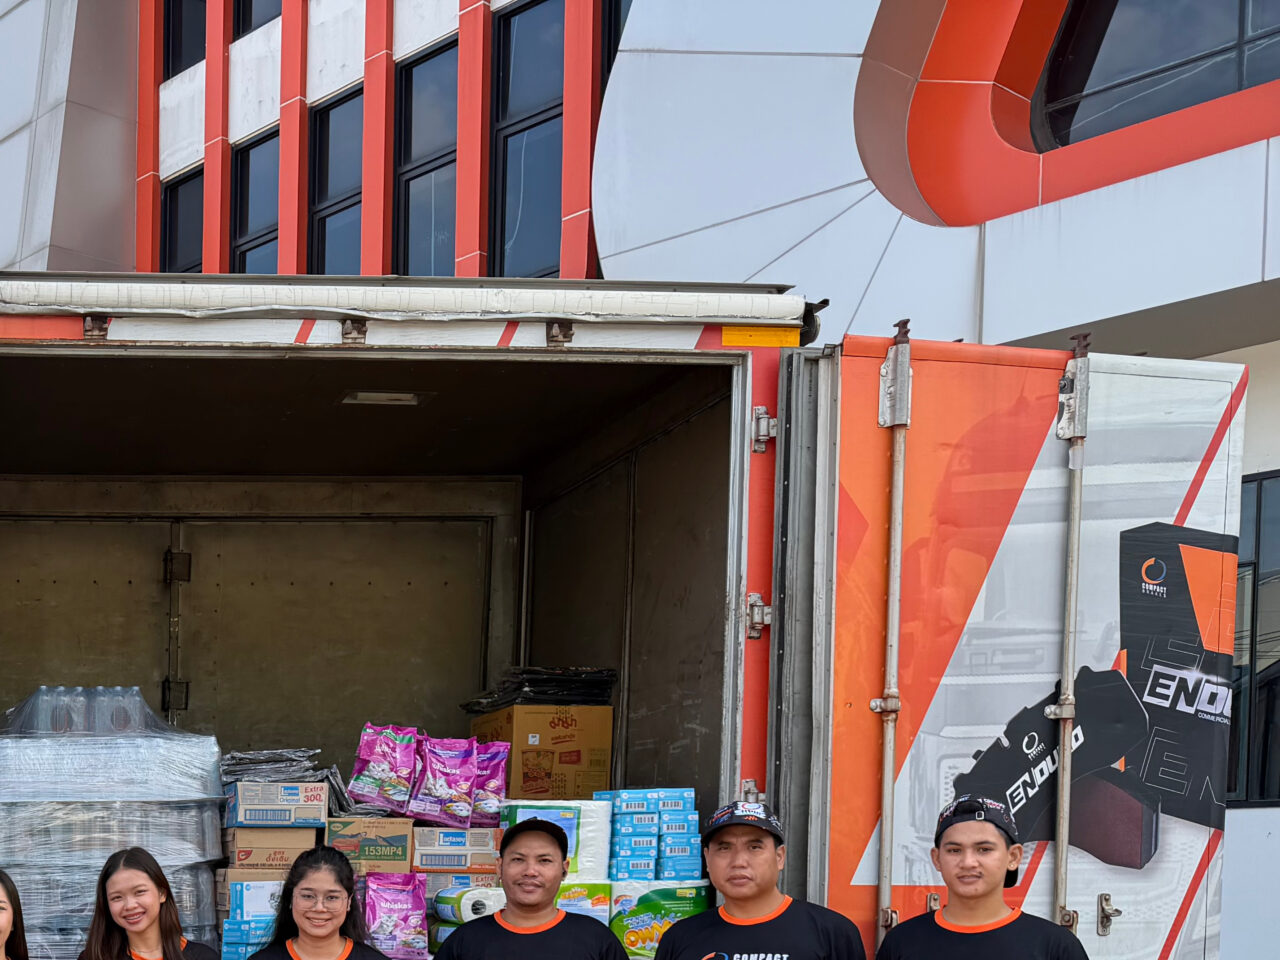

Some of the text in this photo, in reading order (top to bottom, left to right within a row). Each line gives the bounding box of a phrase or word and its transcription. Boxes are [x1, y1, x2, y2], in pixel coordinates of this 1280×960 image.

[1006, 724, 1084, 814] ENDUO
[304, 785, 324, 794] Extra
[364, 846, 403, 856] 153MP4
[380, 901, 412, 909] whiskas
